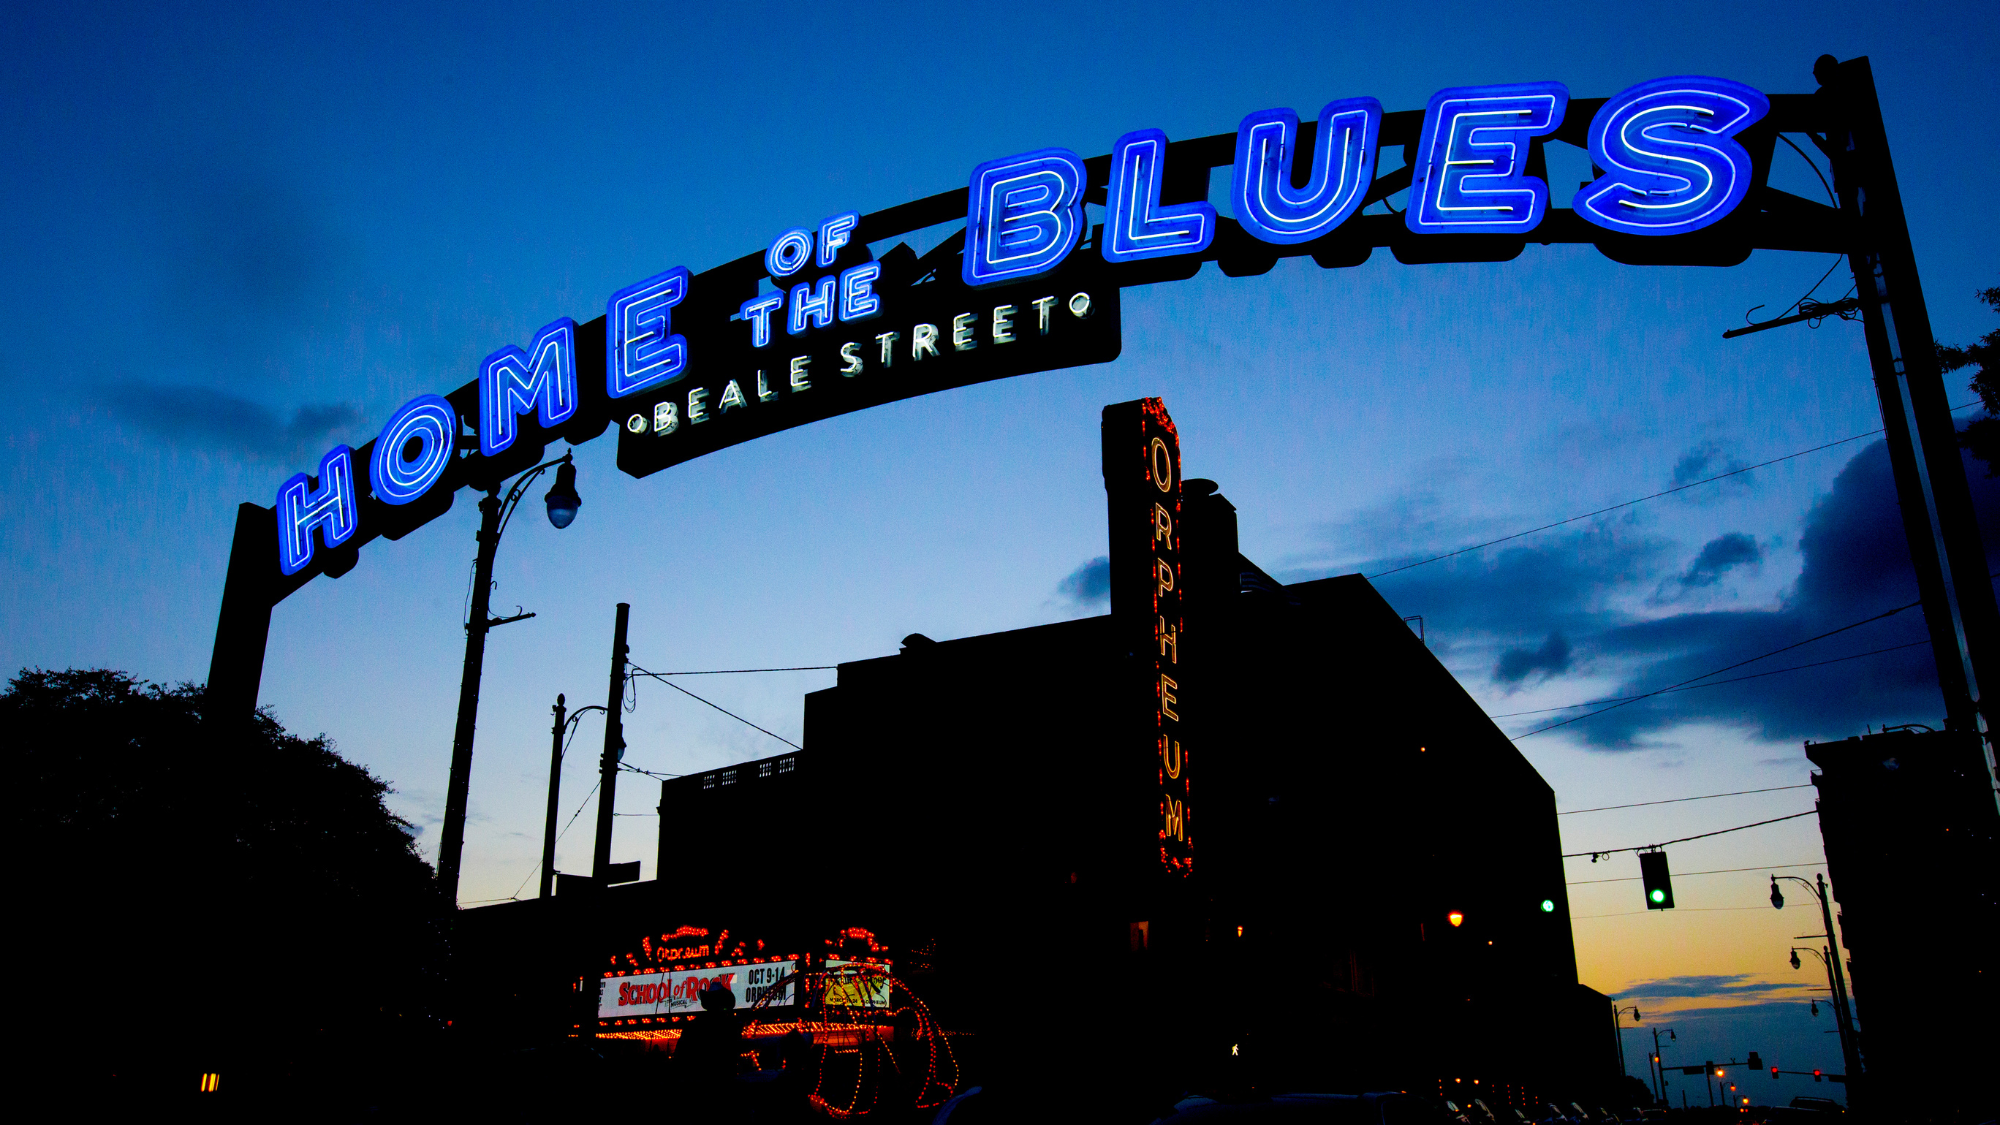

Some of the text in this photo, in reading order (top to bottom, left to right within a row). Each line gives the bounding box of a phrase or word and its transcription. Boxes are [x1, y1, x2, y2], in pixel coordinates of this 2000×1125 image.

[276, 75, 1770, 576] HOME OF THE BLUES
[654, 296, 1055, 437] BEALE STREET
[1151, 436, 1183, 842] ORPHEUM
[673, 980, 686, 999] of
[748, 968, 765, 985] OCT
